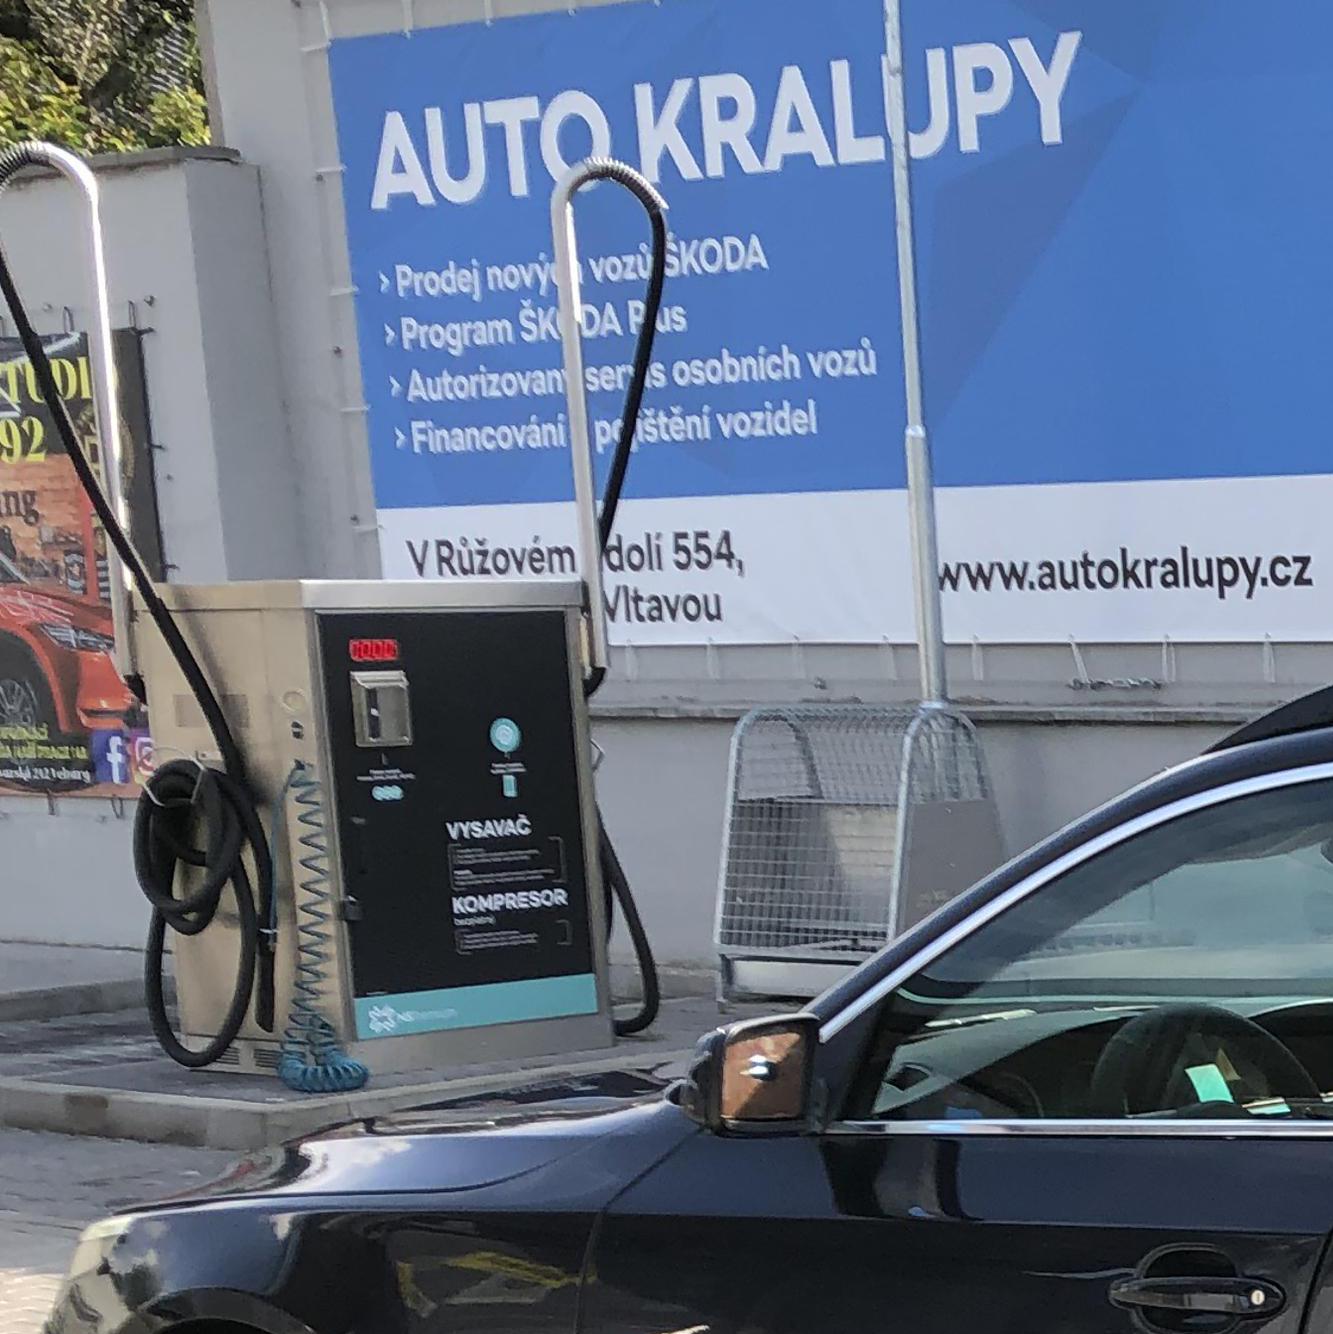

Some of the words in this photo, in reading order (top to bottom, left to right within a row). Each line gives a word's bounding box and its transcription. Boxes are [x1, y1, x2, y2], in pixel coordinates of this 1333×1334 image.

[370, 90, 611, 209] AUTO
[634, 31, 1082, 184] KRALUPY
[396, 265, 483, 300] Prodej
[487, 253, 583, 294] nový
[588, 242, 652, 284] vozů
[664, 232, 769, 278] ŠKODA
[402, 318, 512, 355] Program
[628, 299, 689, 336] Pus
[585, 361, 669, 392] sers
[672, 344, 801, 387] osobních
[807, 337, 878, 378] vozů
[411, 413, 568, 454] Financování
[594, 404, 712, 455] poištění
[717, 399, 818, 439] vozidel
[406, 540, 428, 577] V
[436, 535, 577, 577] Růžovém
[602, 531, 663, 573] dolí
[672, 530, 745, 577] 554,
[938, 545, 1313, 600] www.autokralupy.cz
[446, 813, 532, 840] VYSAVAČ
[452, 888, 569, 915] KOMPRESOR
